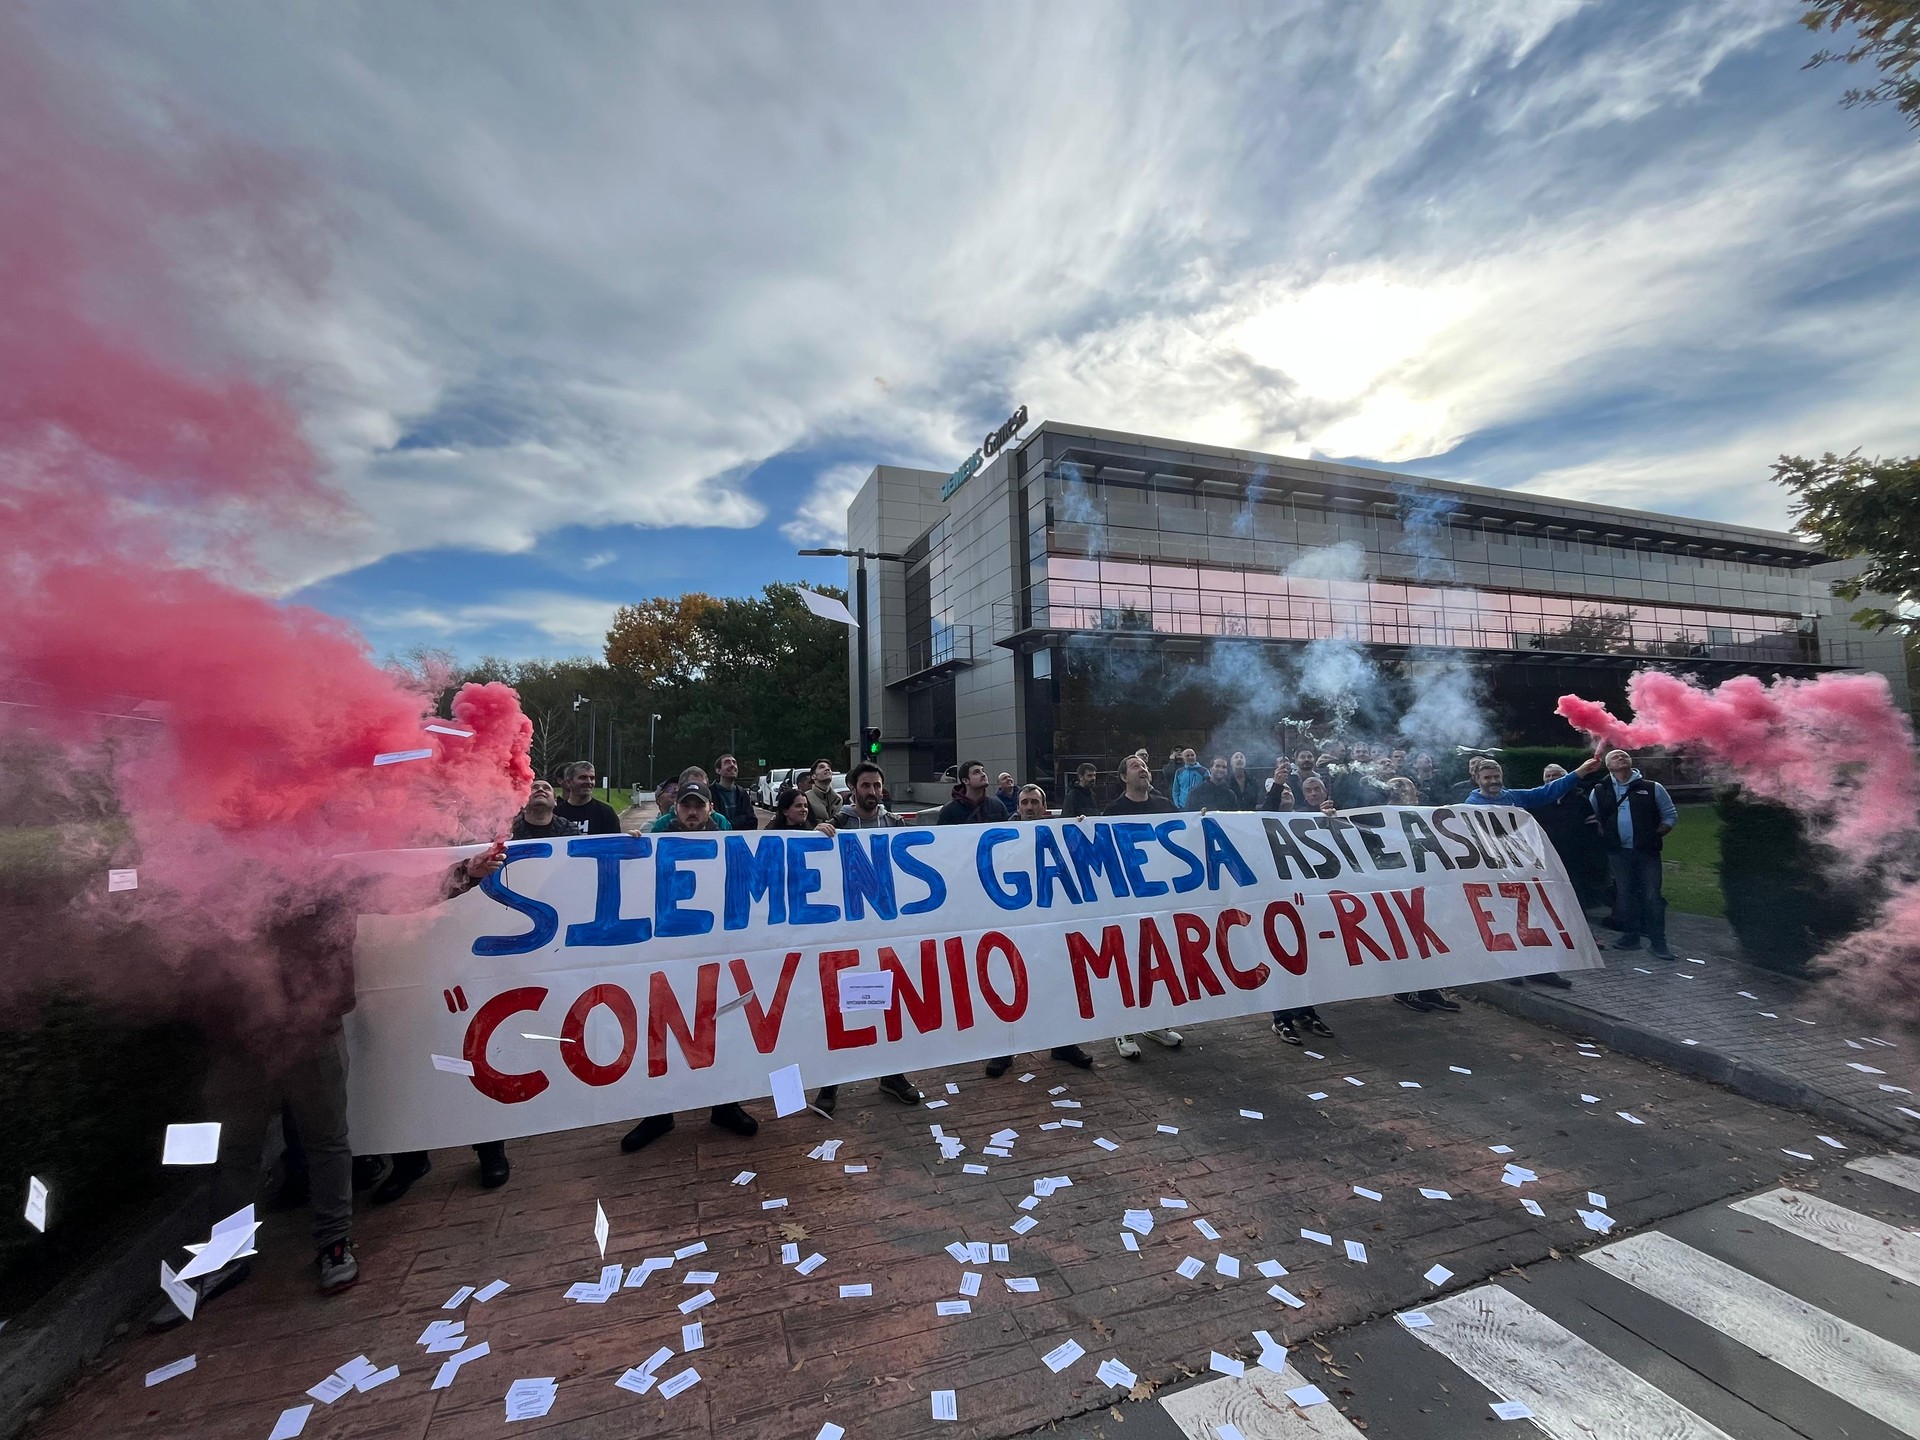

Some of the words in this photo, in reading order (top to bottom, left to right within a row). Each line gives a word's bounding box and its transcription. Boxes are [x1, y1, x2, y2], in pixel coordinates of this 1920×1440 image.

[984, 405, 1029, 458] Gamesa
[471, 830, 947, 957] SIEMENS
[975, 817, 1258, 911] GAMESA
[1261, 807, 1547, 880] ASTEASUN
[444, 931, 1028, 1104] "CONVENIO
[1462, 877, 1575, 952] EZ!
